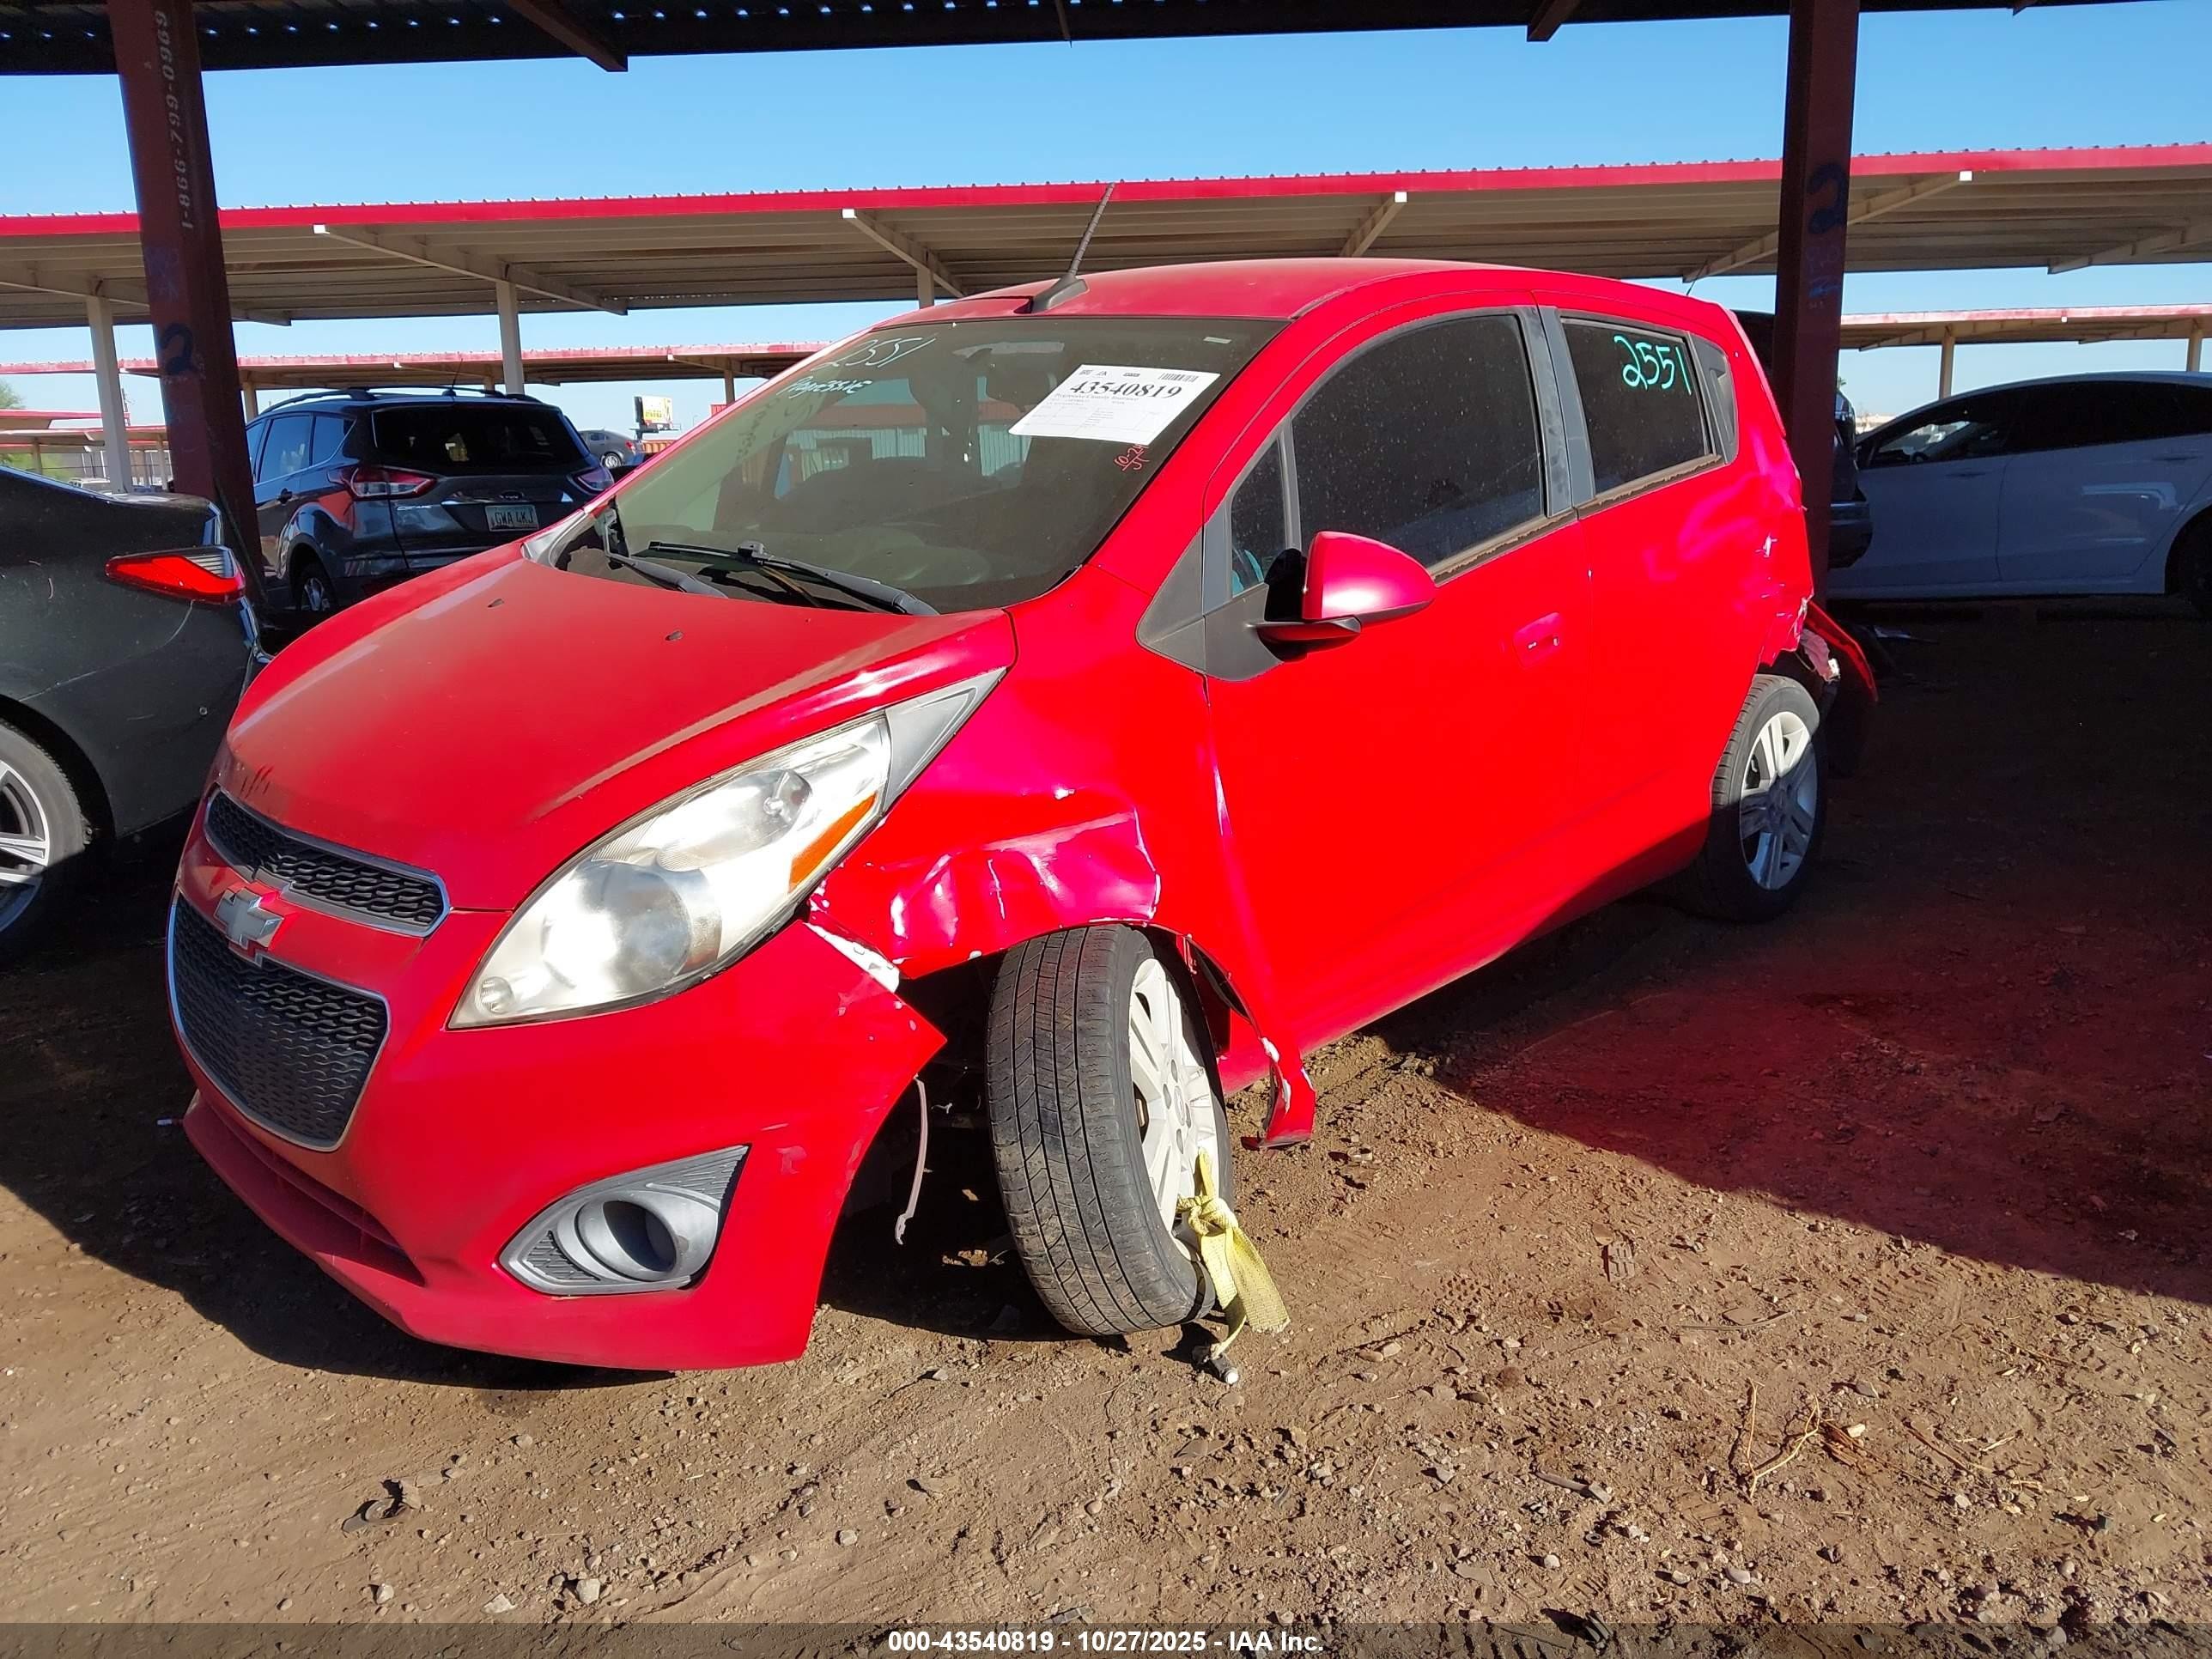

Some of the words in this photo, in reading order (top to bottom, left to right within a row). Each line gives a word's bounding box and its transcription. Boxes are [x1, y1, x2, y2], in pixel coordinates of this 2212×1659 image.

[155, 9, 193, 229] 1-866-799-0969
[1070, 380, 1182, 399] 43540819
[1613, 335, 1692, 395] 2551
